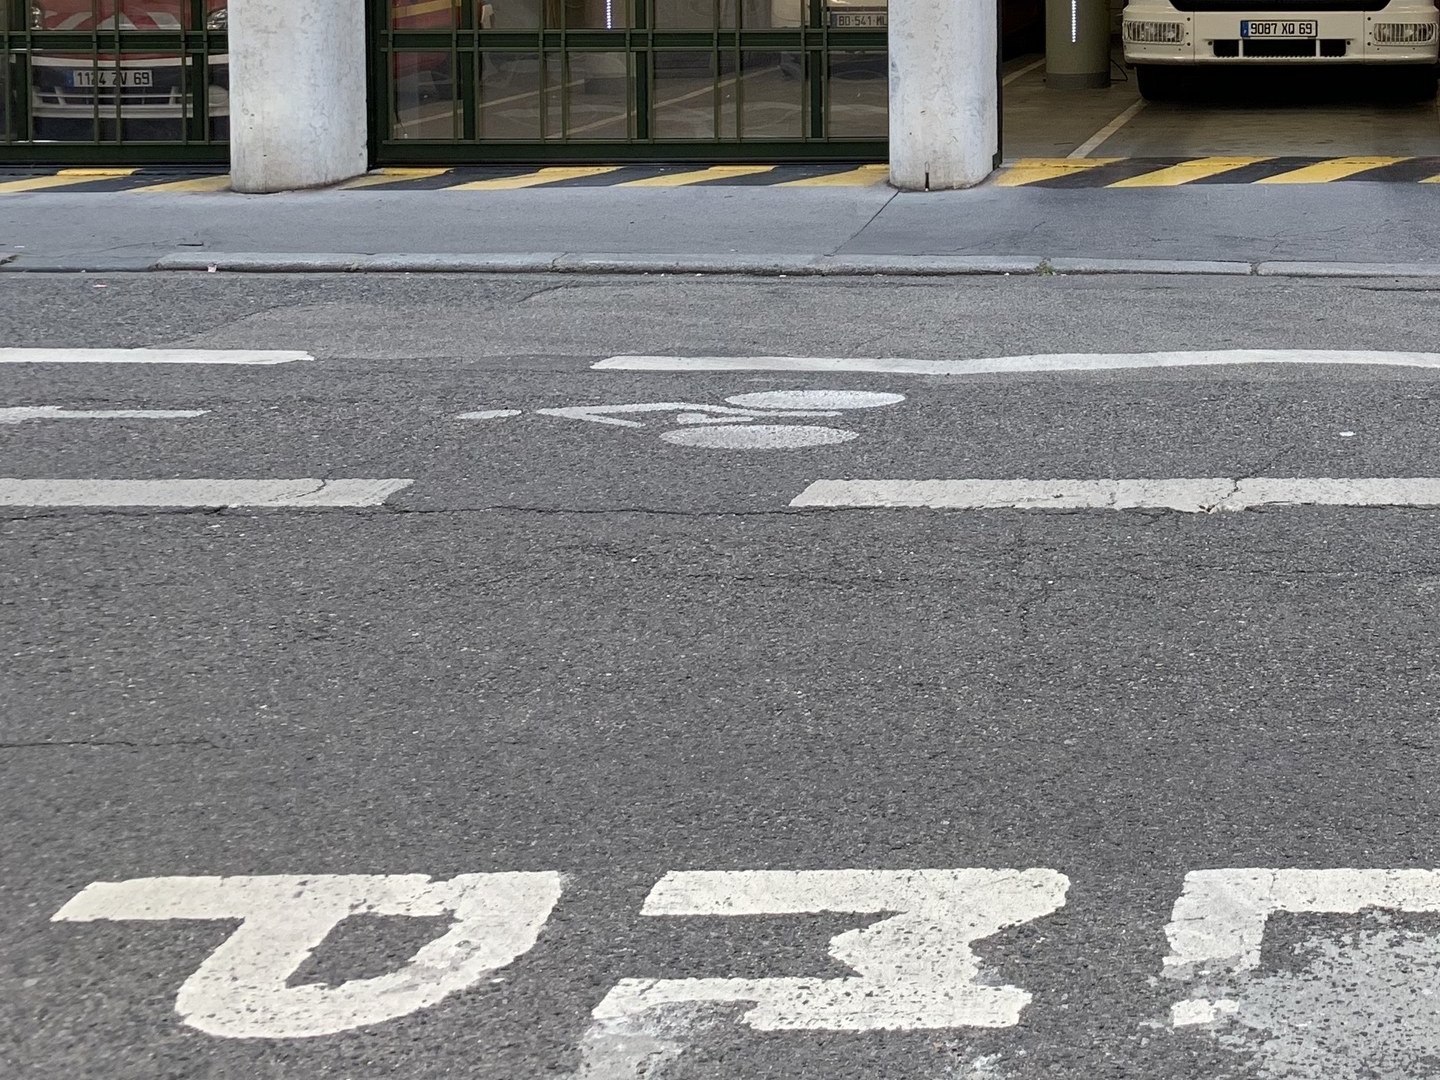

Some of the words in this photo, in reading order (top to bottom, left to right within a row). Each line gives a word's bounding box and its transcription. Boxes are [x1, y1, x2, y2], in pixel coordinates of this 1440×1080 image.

[1250, 22, 1278, 35] 9087
[1281, 22, 1295, 35] XQ
[1298, 22, 1313, 35] 69
[133, 71, 150, 86] 69
